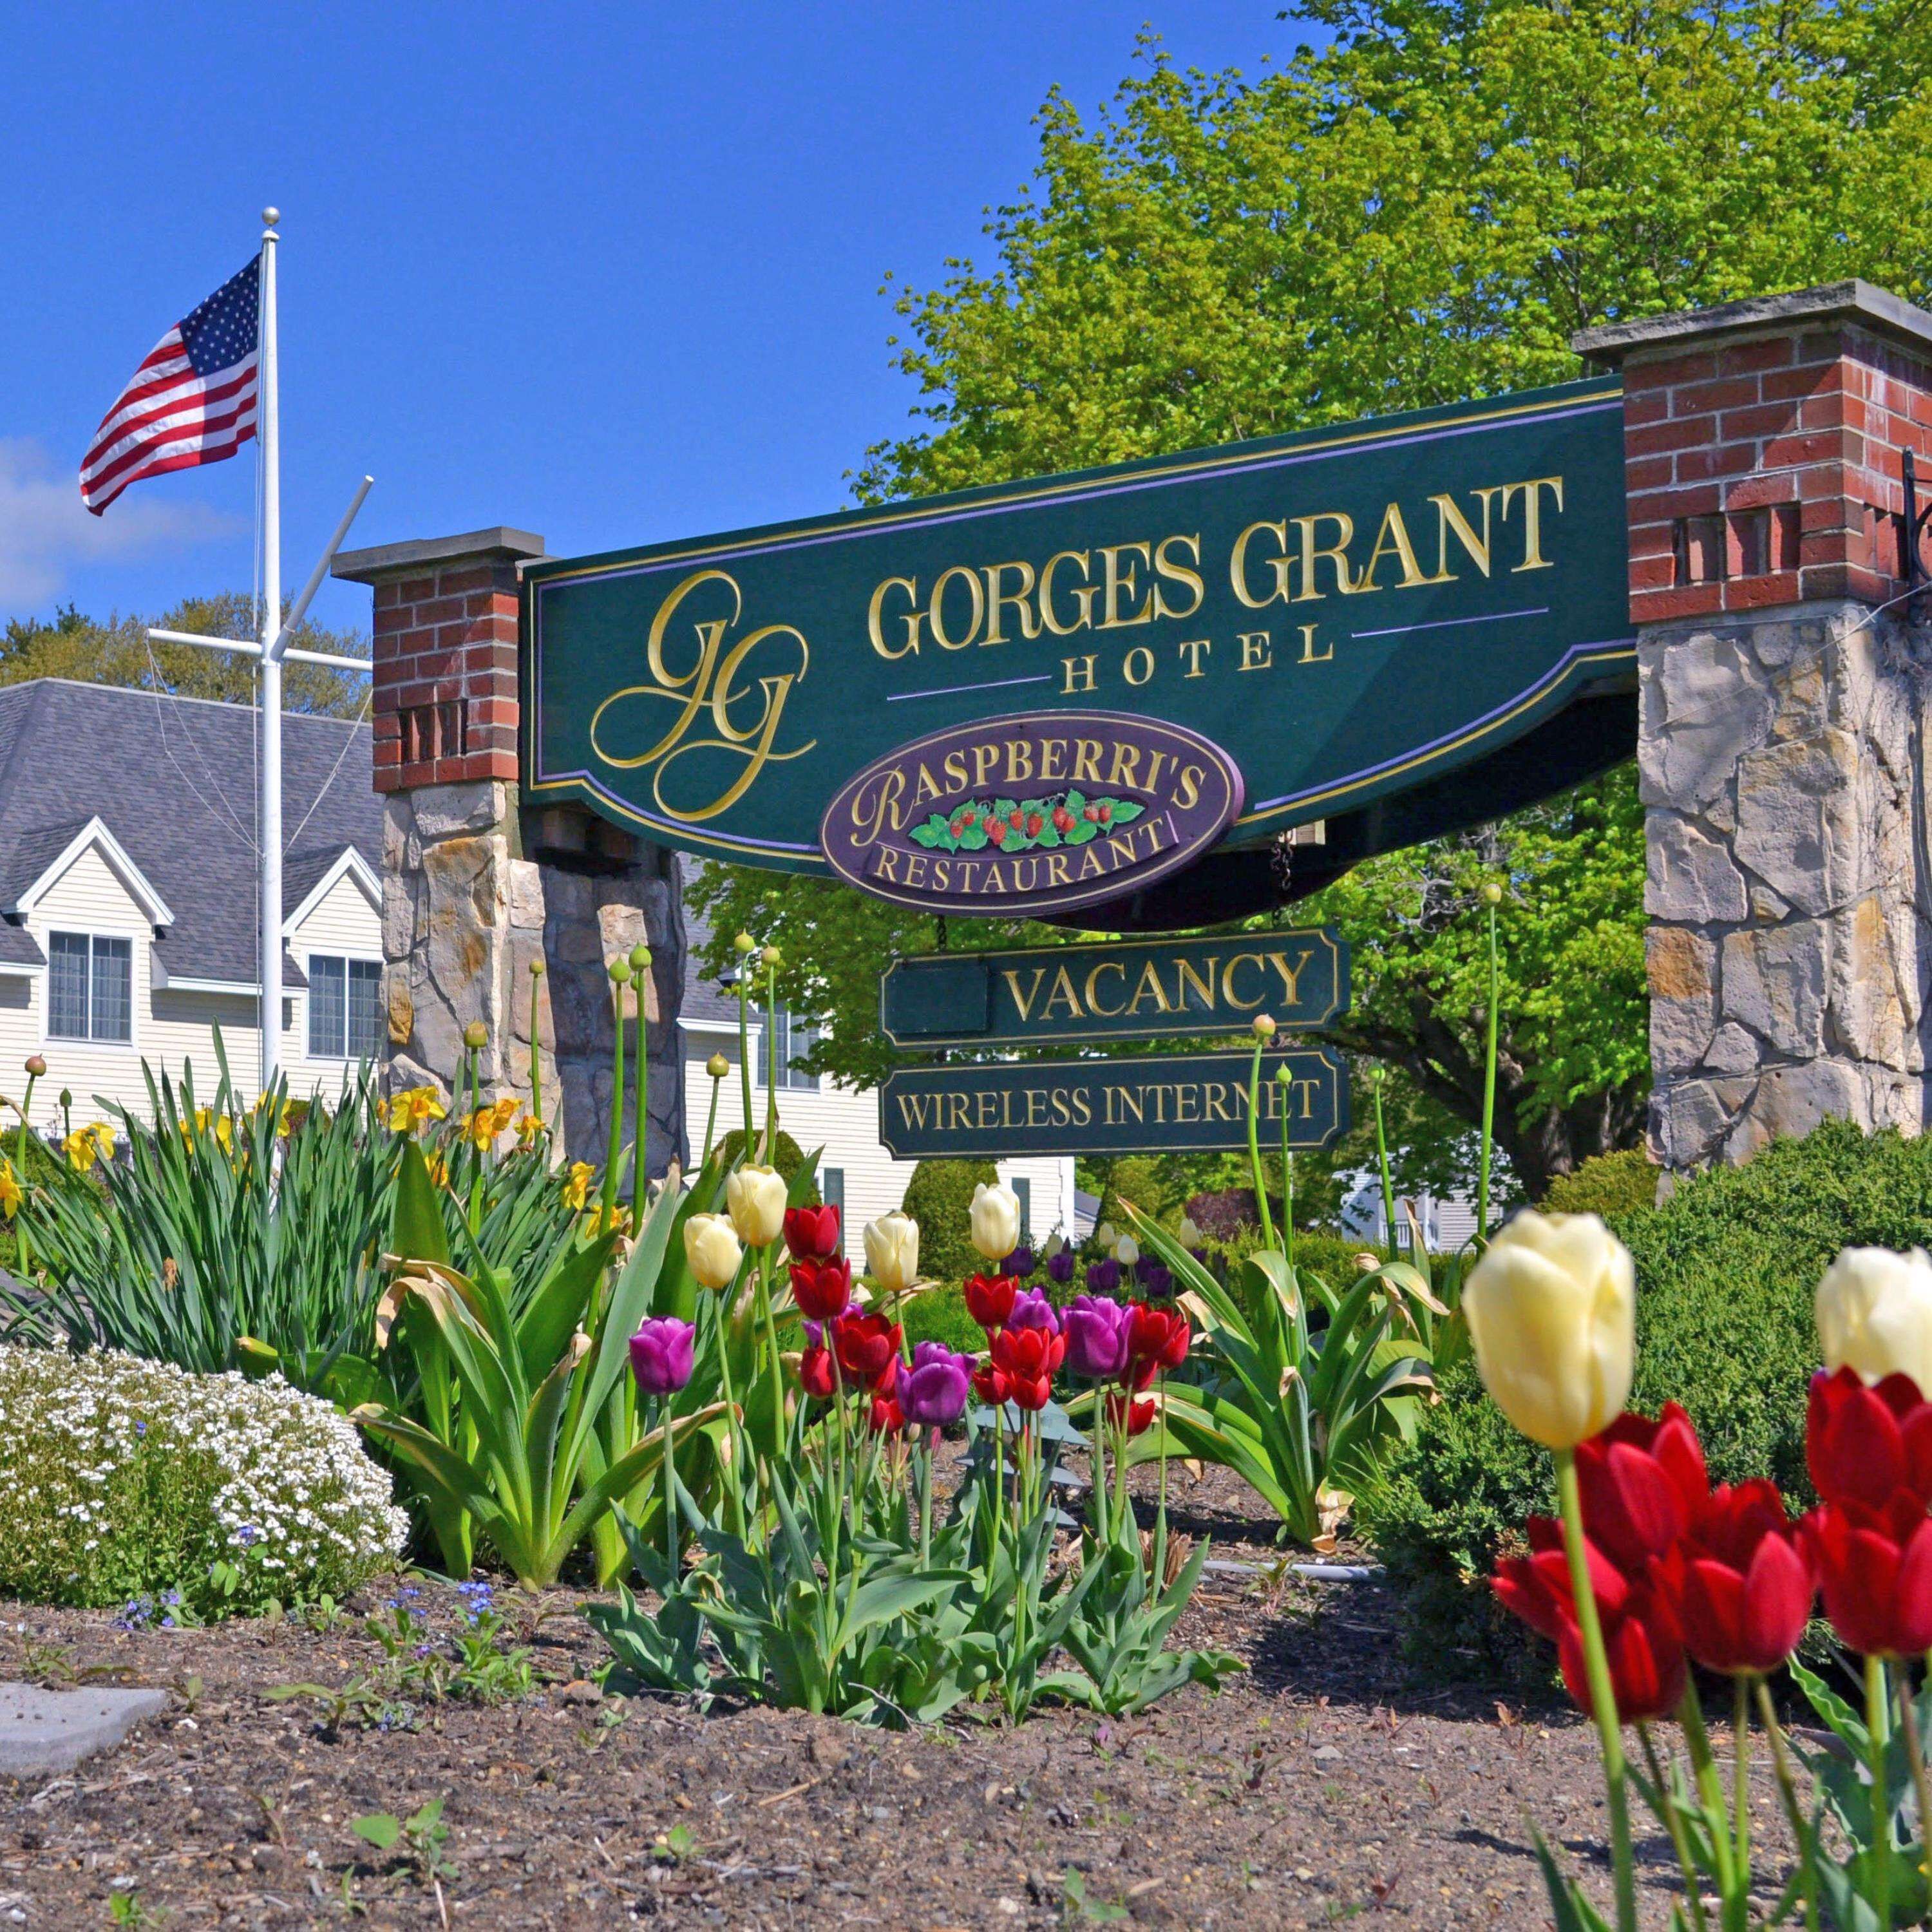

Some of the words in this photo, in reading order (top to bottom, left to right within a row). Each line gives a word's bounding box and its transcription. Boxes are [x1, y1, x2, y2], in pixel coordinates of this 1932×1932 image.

[868, 533, 1204, 660] GORGES
[1230, 475, 1563, 609] GRANT
[1059, 623, 1334, 695] HOTEL
[850, 738, 1207, 847] RASPBERRI'S
[873, 817, 1164, 893] RESTAURANT
[1001, 950, 1315, 1022] VACANCY
[896, 1086, 1092, 1131] WIRELESS
[1102, 1079, 1321, 1124] INTERNET
